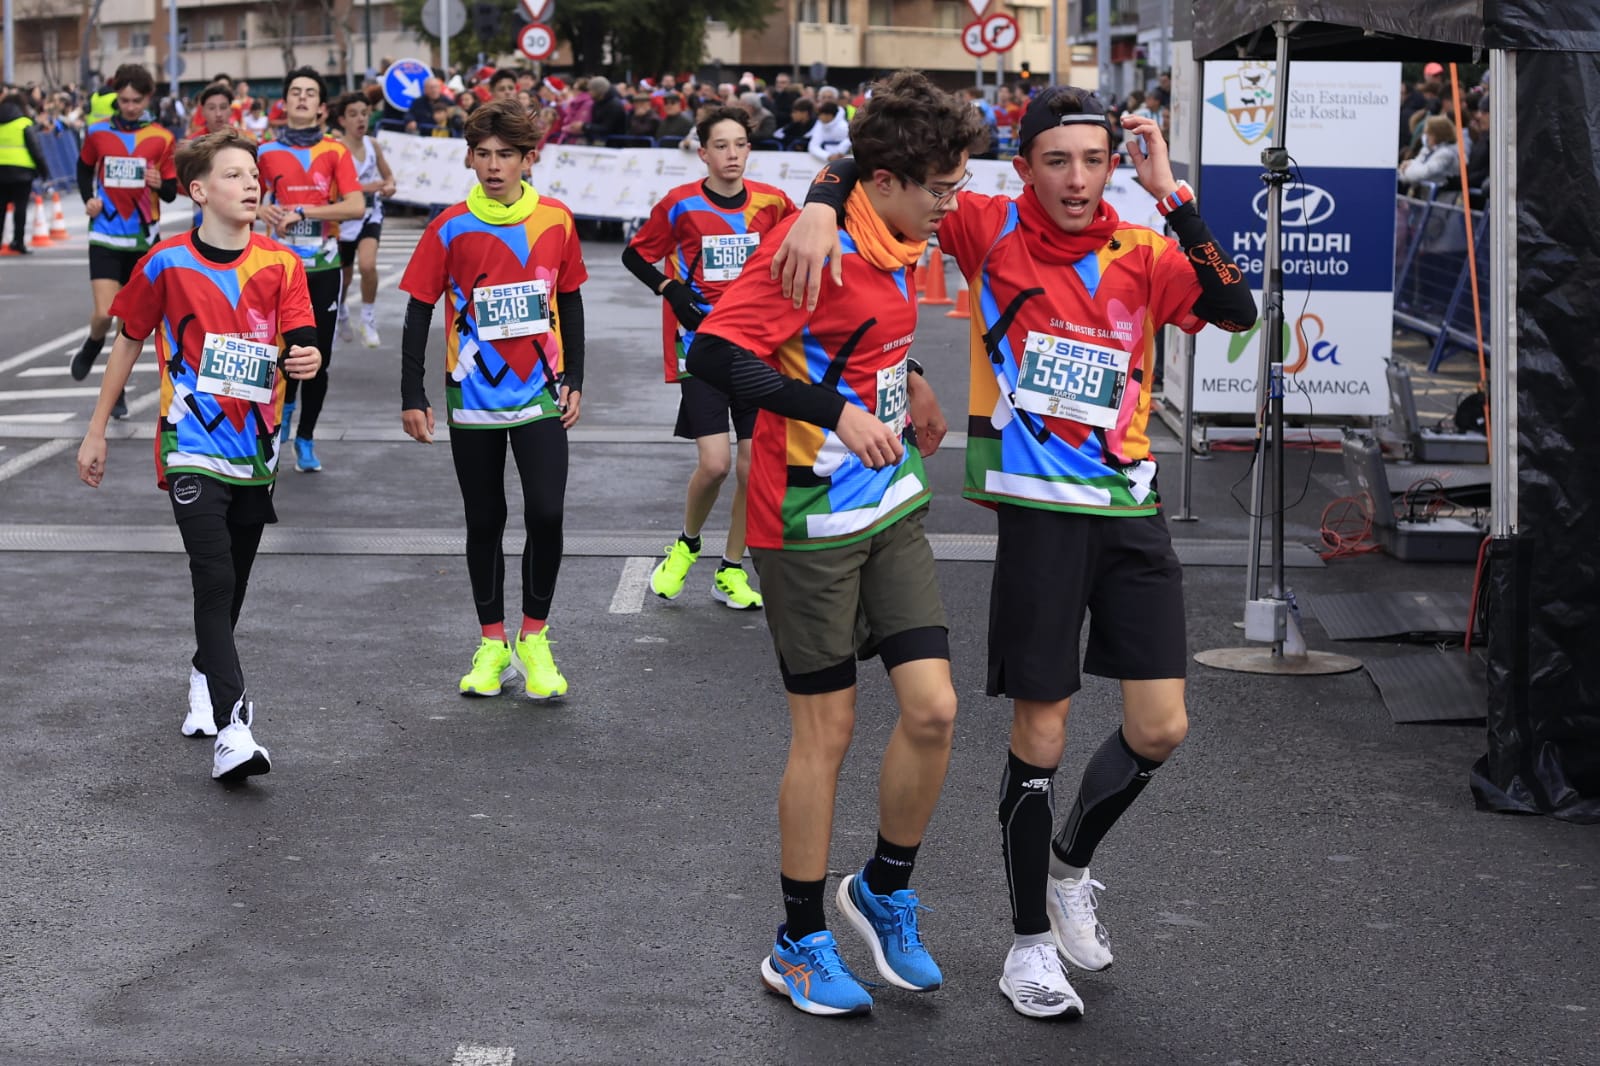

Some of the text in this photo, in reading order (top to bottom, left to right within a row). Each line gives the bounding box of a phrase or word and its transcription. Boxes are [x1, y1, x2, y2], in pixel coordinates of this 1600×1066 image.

[527, 36, 547, 48] 30
[1290, 90, 1389, 105] San Estanislao
[1289, 105, 1357, 119] de Kostka
[1233, 232, 1351, 253] HYNDAI
[713, 246, 747, 266] 5618
[1234, 253, 1349, 275] Georauto
[492, 284, 540, 298] SETEL
[487, 296, 529, 322] 5418
[1050, 318, 1064, 329] SAN
[1065, 321, 1097, 337] SILVESTRE
[226, 341, 271, 358] SETEL
[1055, 342, 1119, 368] SETEL
[211, 350, 260, 382] 5630
[1033, 355, 1105, 399] 5539
[1053, 389, 1077, 400] MARIO
